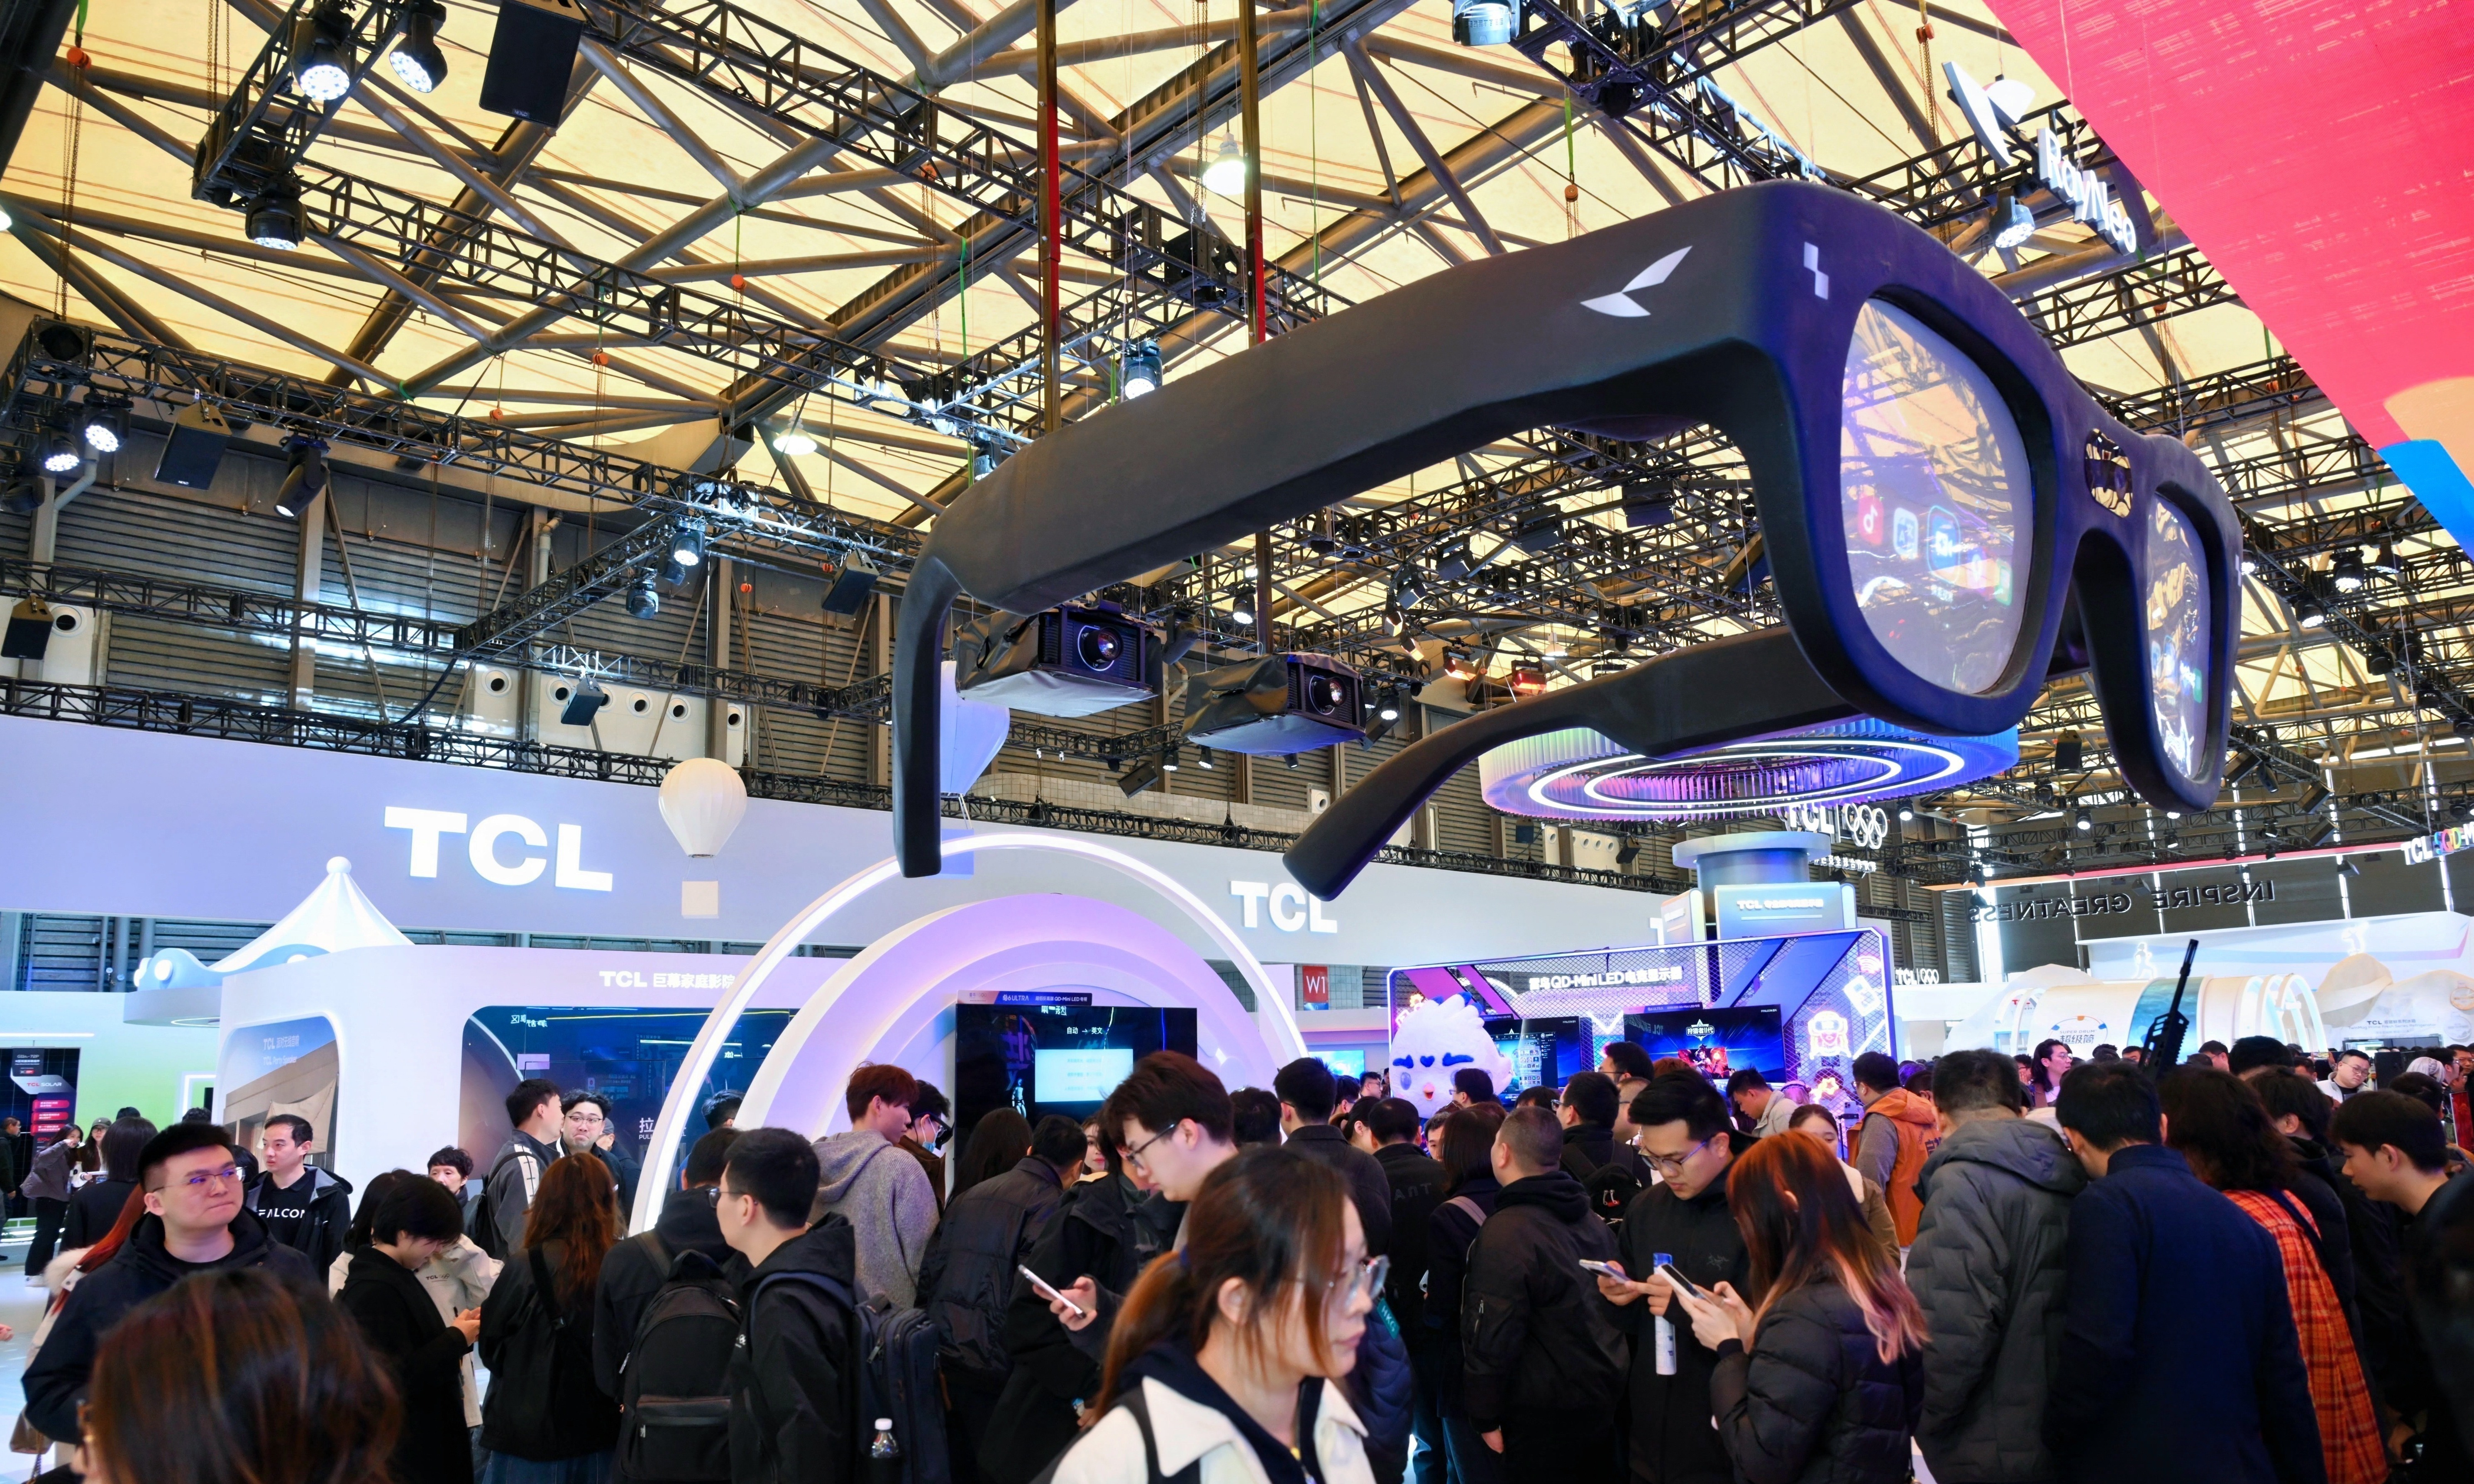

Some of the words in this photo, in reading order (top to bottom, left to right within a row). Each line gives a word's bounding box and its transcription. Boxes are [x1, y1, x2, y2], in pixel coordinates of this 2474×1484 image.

[2038, 127, 2137, 256] RayNeo
[384, 806, 613, 891] TCL
[2401, 836, 2432, 865] TCL
[1230, 881, 1338, 933] TCL
[1737, 900, 1763, 910] TCL
[599, 971, 647, 987] TCL
[653, 972, 735, 989] 巨幕家庭影院
[1306, 976, 1325, 994] W1
[1598, 971, 1624, 986] LED
[1895, 969, 1917, 985] TCL
[263, 1037, 275, 1050] TCL
[2060, 1034, 2095, 1044] 超级筒
[639, 1117, 654, 1133] 拉
